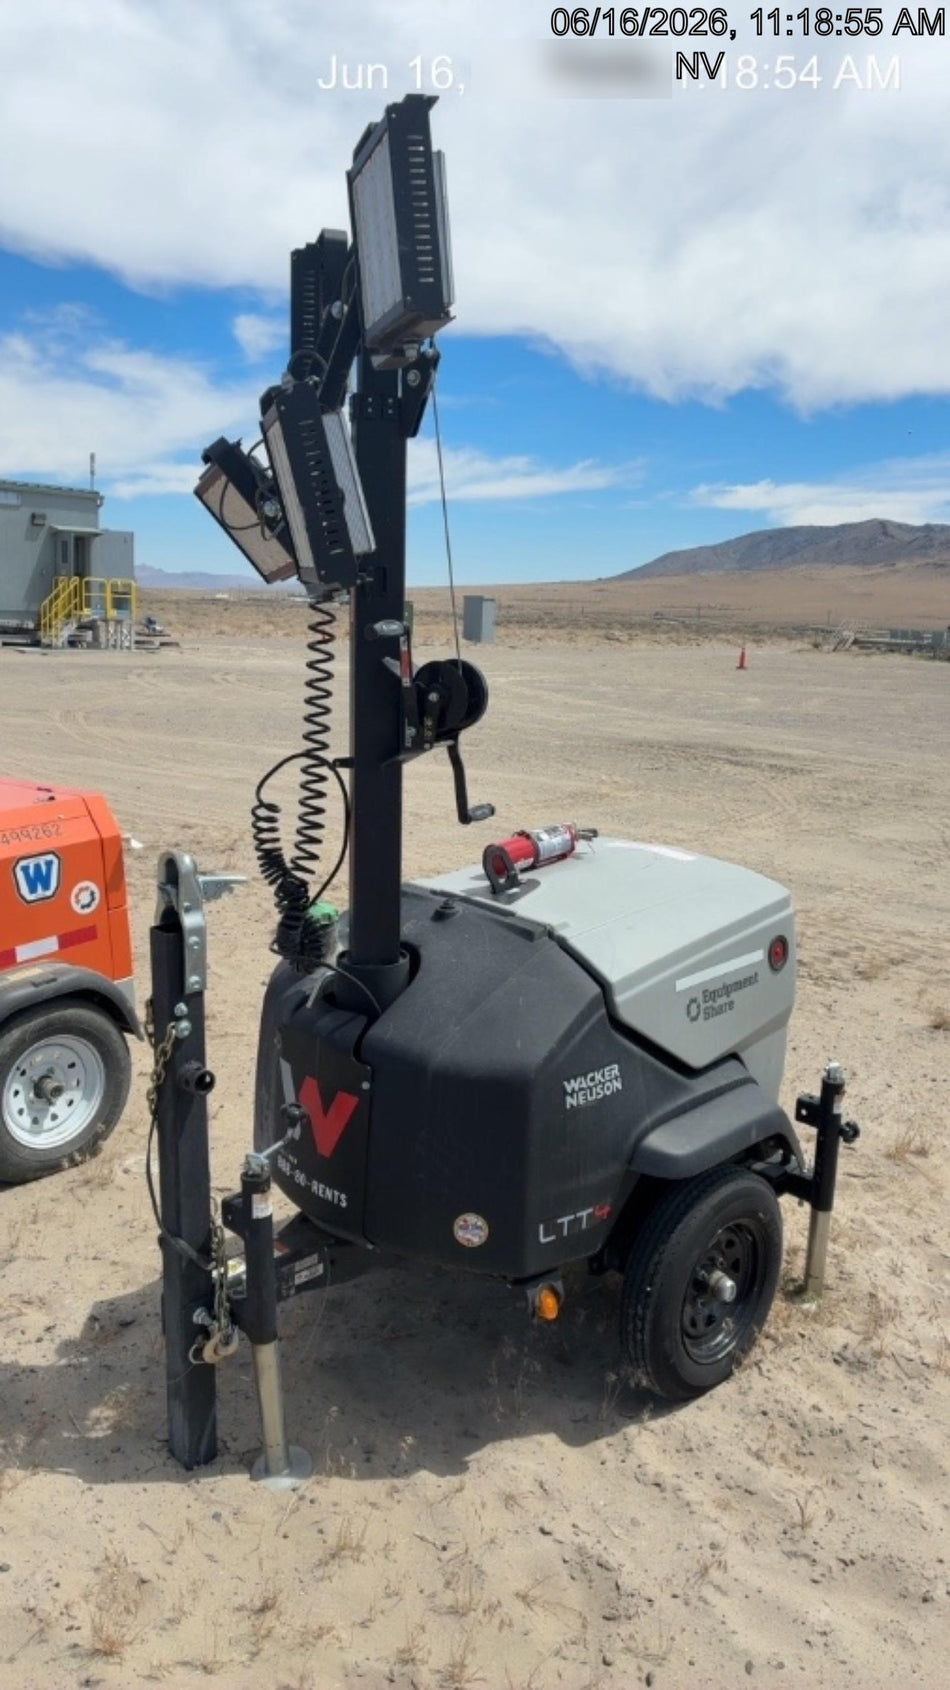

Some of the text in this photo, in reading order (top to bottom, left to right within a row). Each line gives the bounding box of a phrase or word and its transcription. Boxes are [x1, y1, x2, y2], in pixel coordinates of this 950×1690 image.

[20, 859, 54, 895] W
[702, 972, 760, 1004] Equipment
[703, 1000, 736, 1021] Share
[563, 1064, 620, 1094] WACKER
[565, 1078, 623, 1110] NEUSON
